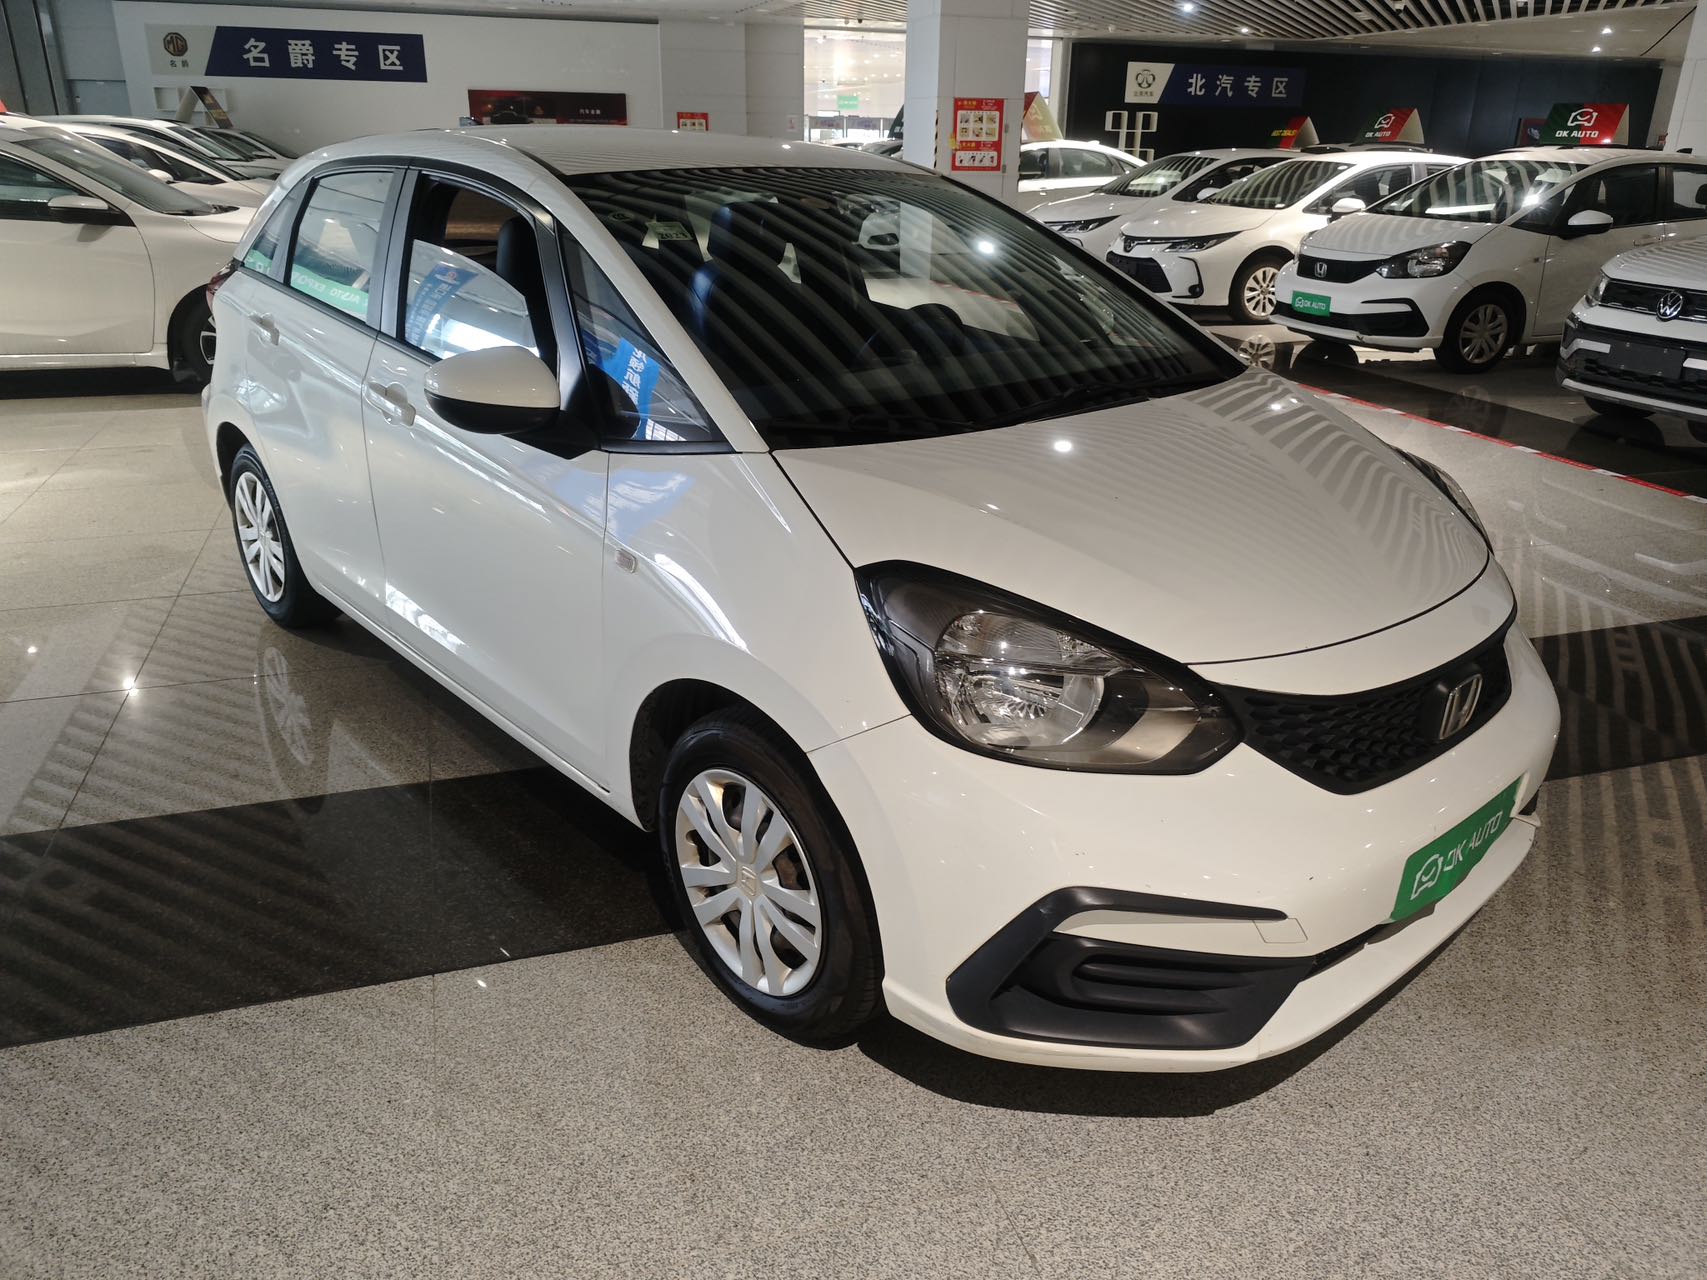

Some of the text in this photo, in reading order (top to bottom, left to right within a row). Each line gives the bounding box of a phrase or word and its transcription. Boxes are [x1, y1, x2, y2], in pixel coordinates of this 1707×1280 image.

[243, 38, 403, 70] 名爵专区
[1187, 74, 1288, 97] 北汽专区
[1555, 130, 1599, 138] OK AUTO
[1468, 810, 1504, 850] AUTO
